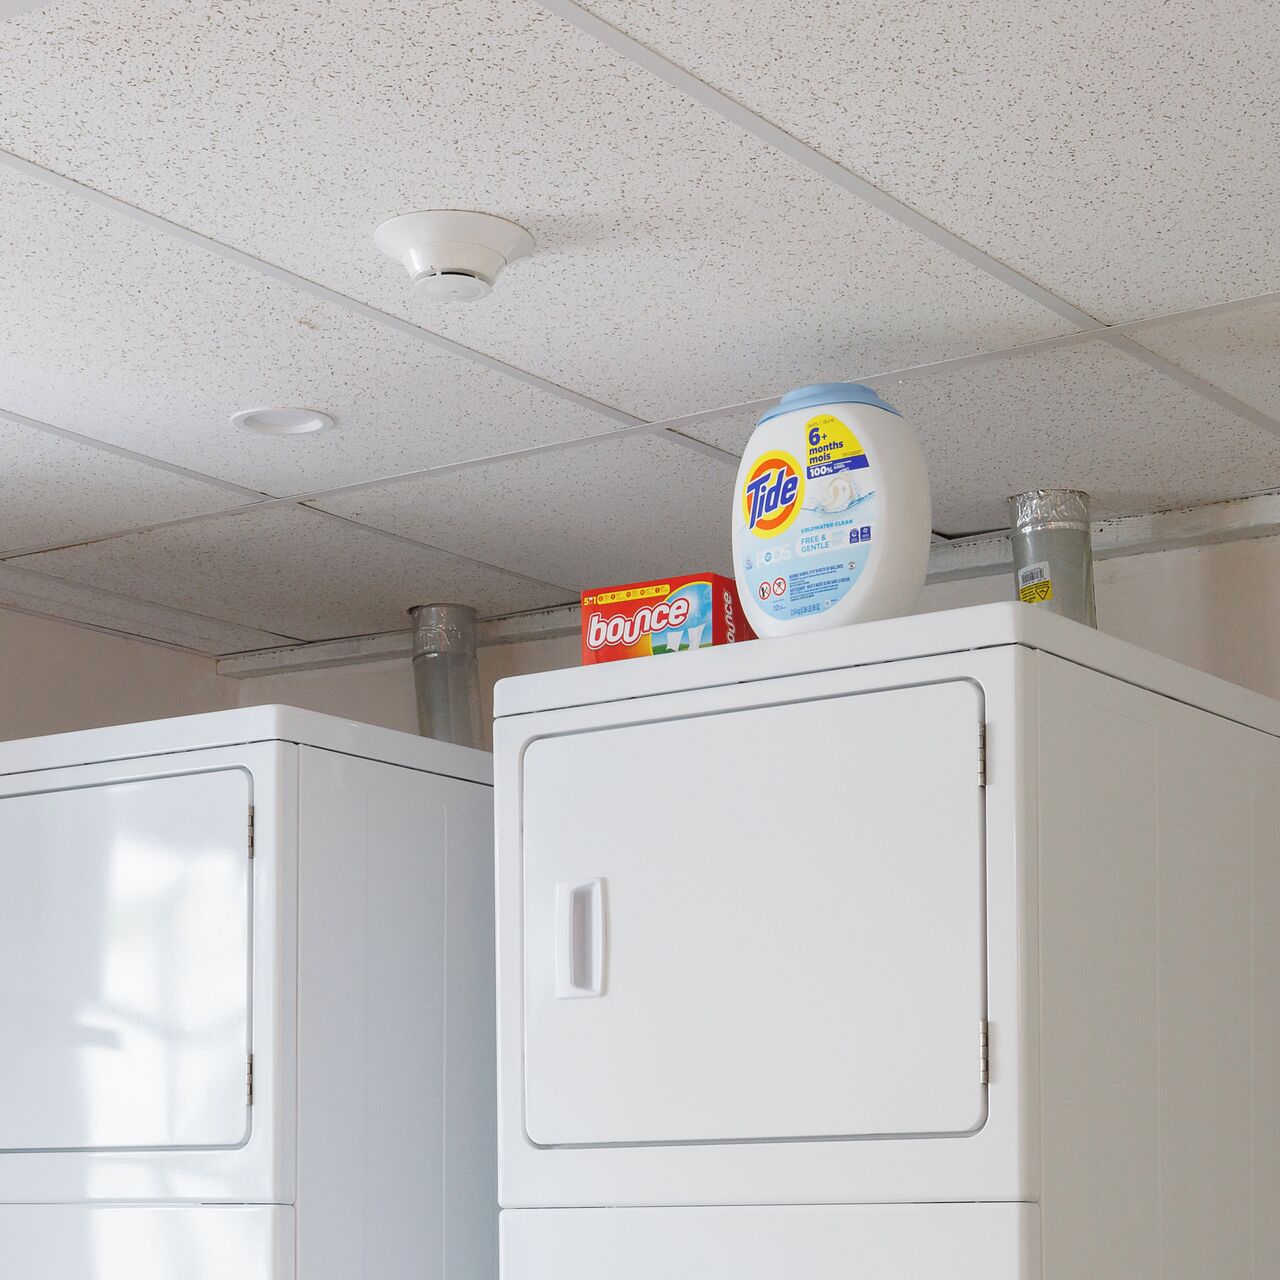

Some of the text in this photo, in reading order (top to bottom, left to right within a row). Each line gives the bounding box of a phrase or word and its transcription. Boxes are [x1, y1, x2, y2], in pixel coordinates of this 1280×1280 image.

[809, 440, 844, 455] months
[809, 452, 831, 464] mois
[809, 465, 833, 478] 100%
[746, 466, 800, 530] Tide
[800, 519, 853, 534] COLDWATER CLEAN
[800, 534, 819, 546] FREE
[821, 533, 827, 541] &
[801, 541, 830, 553] GENTLE
[587, 598, 690, 650] bounce
[723, 591, 736, 644] ounce
